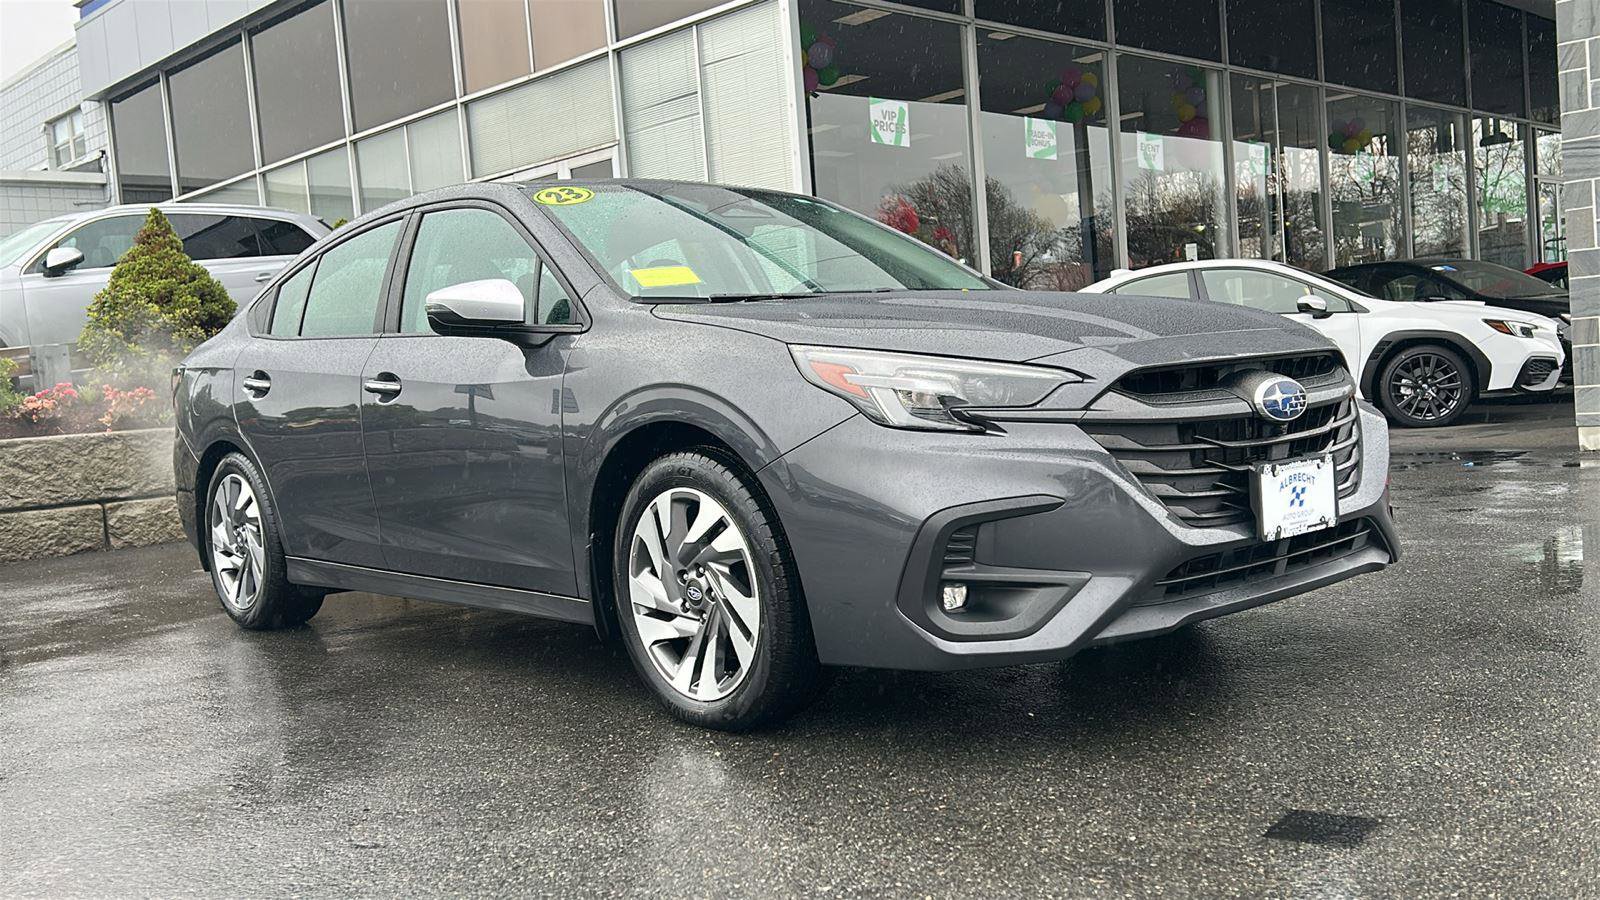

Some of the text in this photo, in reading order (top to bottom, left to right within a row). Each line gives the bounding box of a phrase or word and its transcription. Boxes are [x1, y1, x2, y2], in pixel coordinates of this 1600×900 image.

[881, 110, 897, 121] VIP
[874, 119, 906, 134] PRICES
[545, 188, 583, 203] 23
[1279, 472, 1315, 492] ALBRECHT
